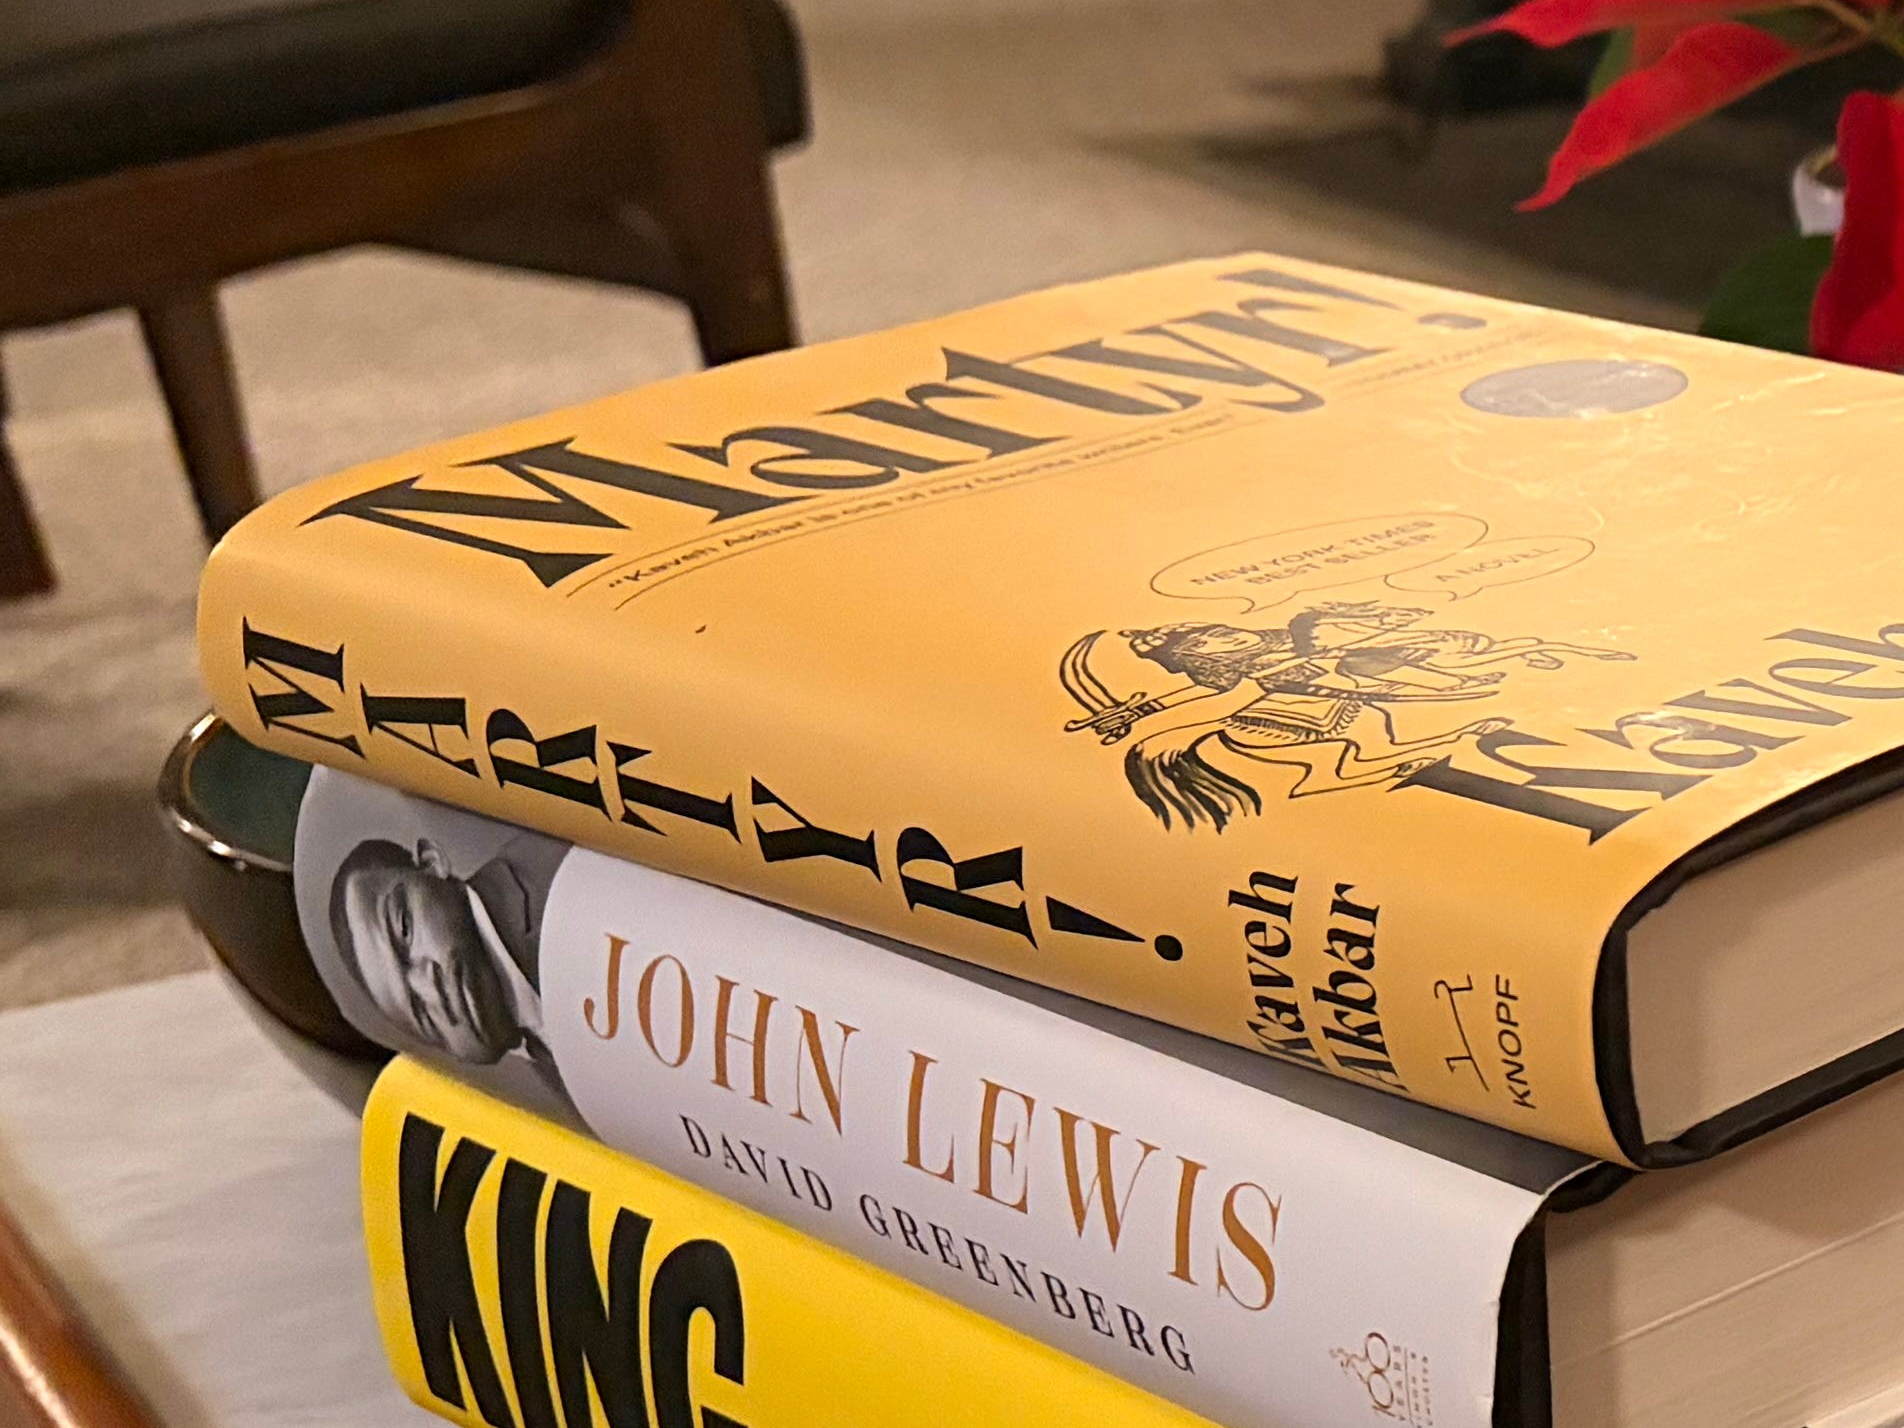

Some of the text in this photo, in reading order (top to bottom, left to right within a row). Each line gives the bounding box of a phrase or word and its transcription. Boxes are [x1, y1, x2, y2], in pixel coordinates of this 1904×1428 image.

[300, 269, 1487, 588] Martyr!
[1190, 520, 1435, 585] NEW YORK TIMES
[1245, 533, 1435, 585] BEST SELLER
[1434, 546, 1562, 582] A NOVEL
[242, 615, 1184, 962] MARTYR!
[1228, 870, 1330, 1073] Kaveh
[1312, 881, 1411, 1094] Akbar
[1495, 973, 1537, 1110] KNOPF
[583, 933, 1285, 1312] JOHN LEWIS
[680, 1114, 1199, 1375] DAVID GREENBERG
